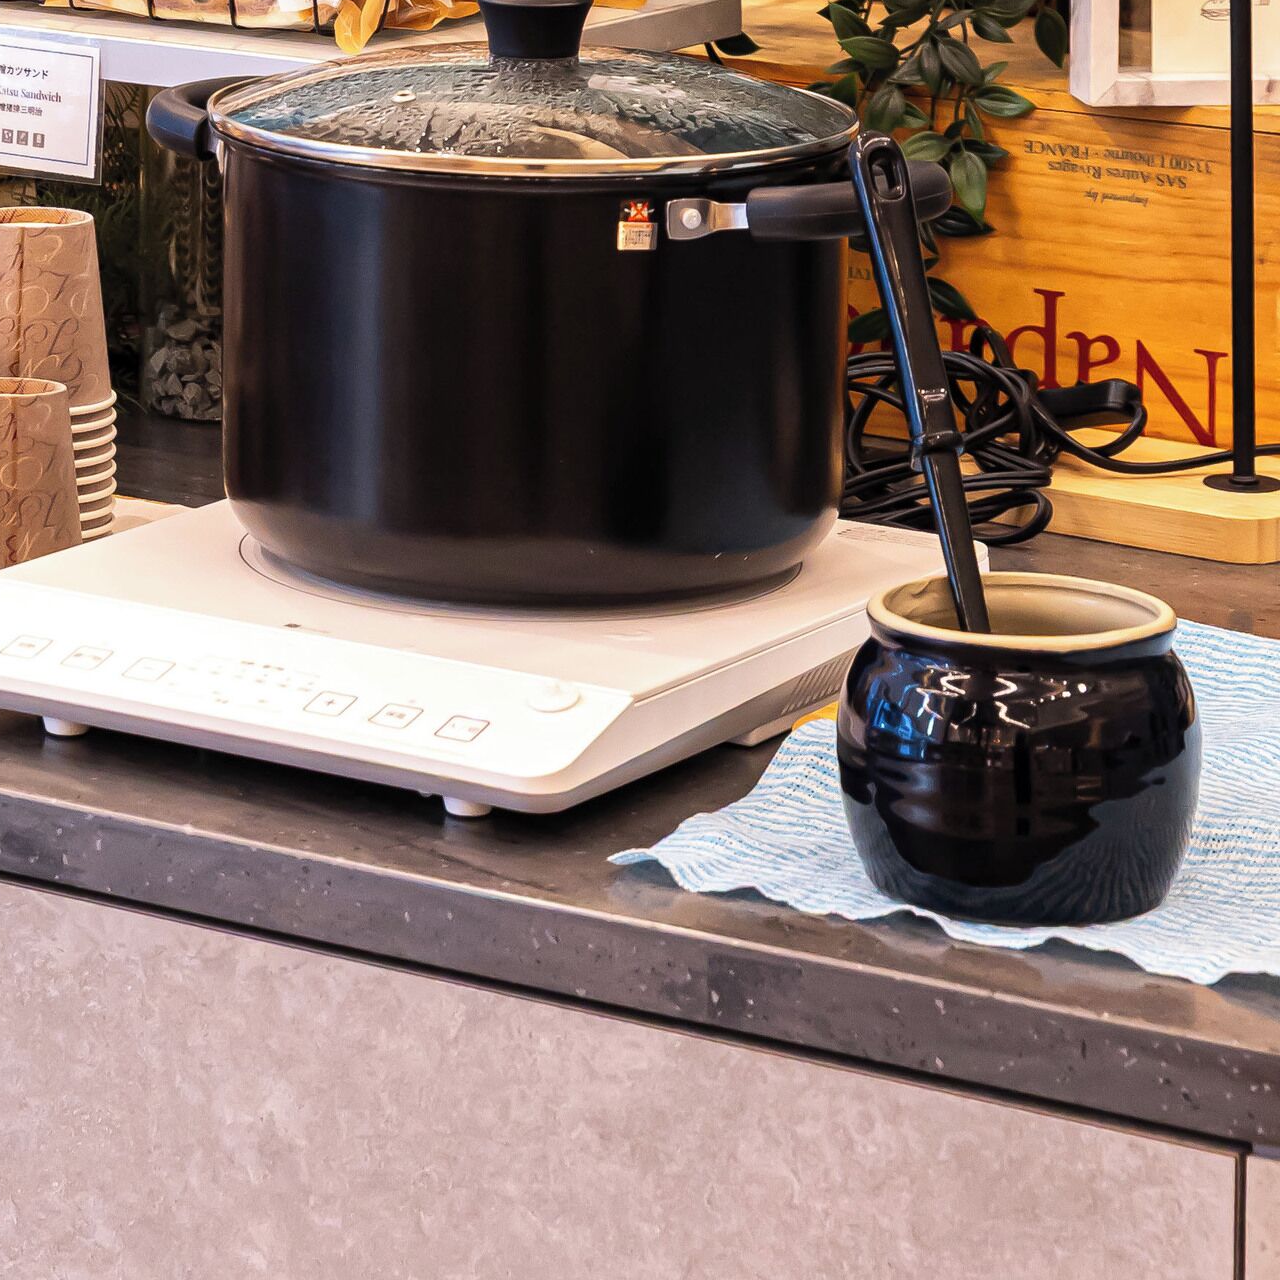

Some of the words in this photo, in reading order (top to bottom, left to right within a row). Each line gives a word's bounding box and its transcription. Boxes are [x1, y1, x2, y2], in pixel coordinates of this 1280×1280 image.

[20, 89, 63, 103] Sandwich
[1024, 139, 1089, 160] FRANCE
[1155, 173, 1187, 189] SAS
